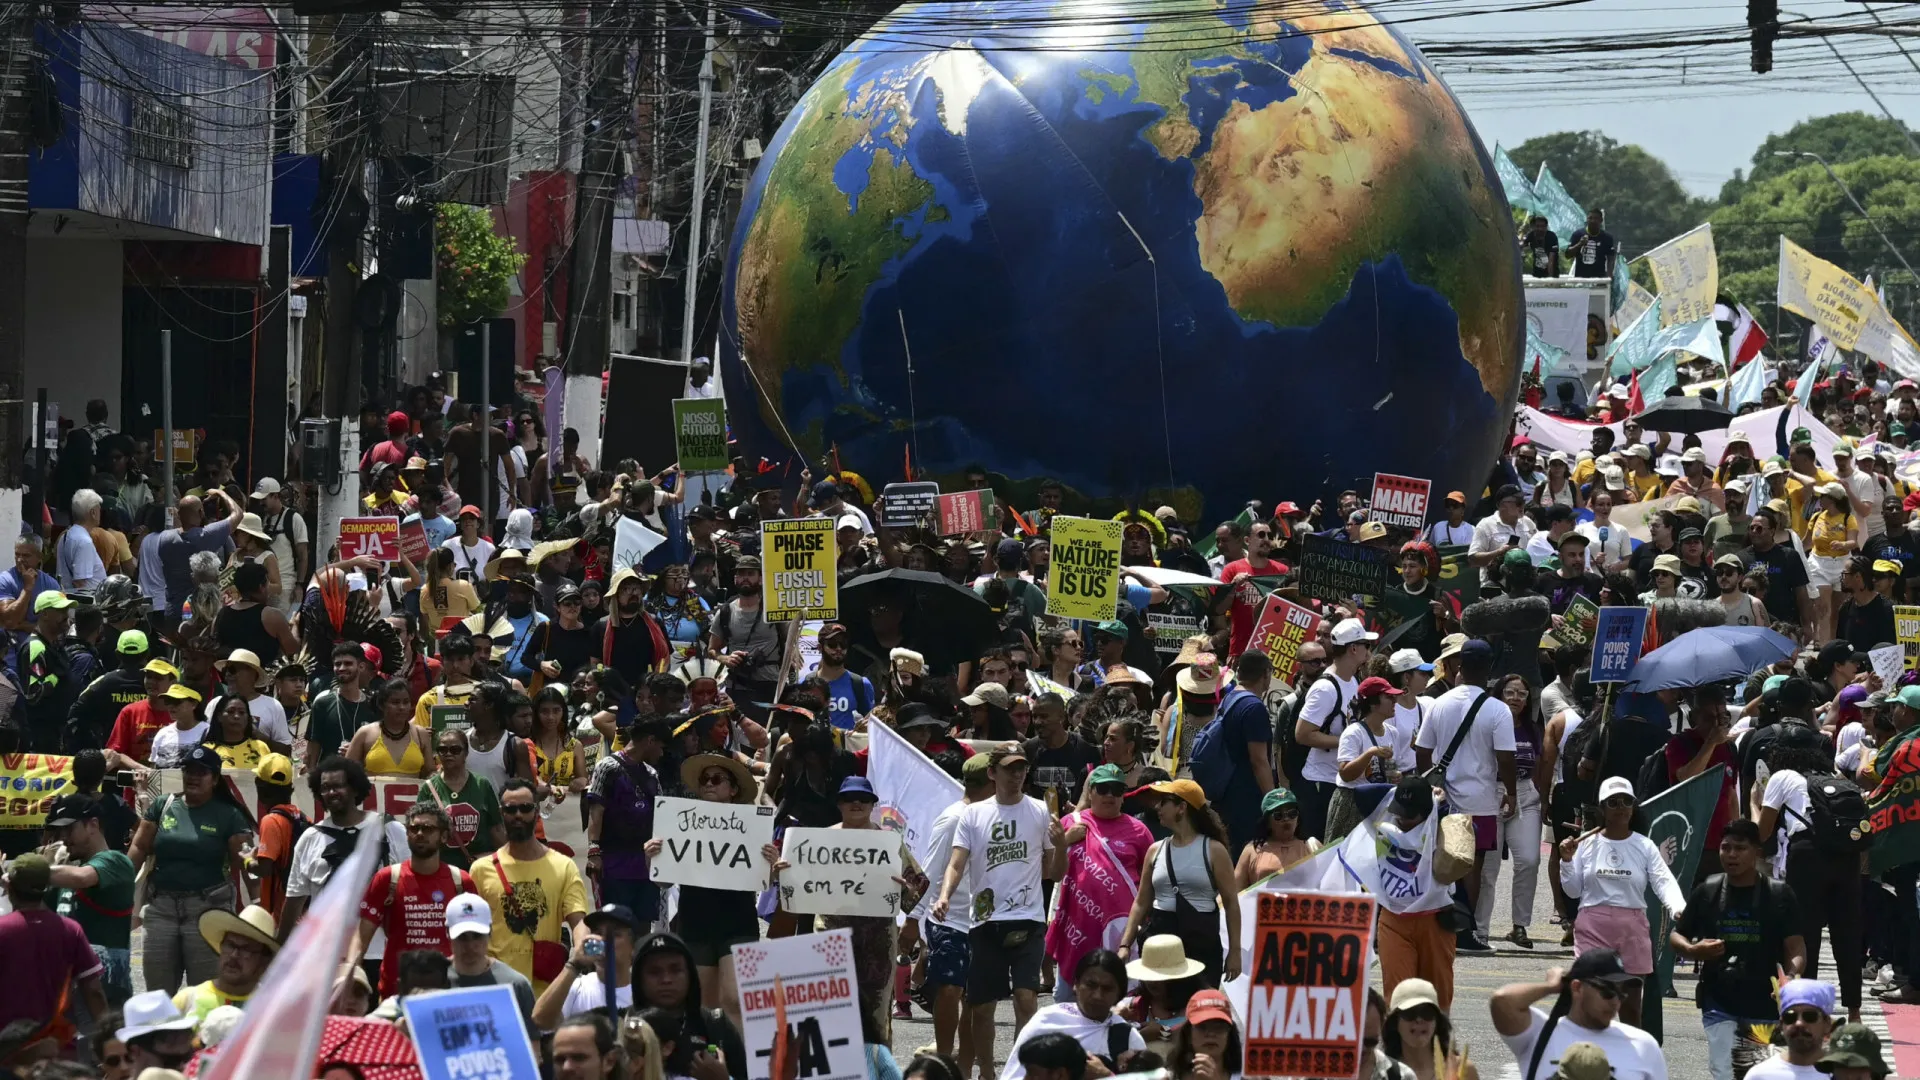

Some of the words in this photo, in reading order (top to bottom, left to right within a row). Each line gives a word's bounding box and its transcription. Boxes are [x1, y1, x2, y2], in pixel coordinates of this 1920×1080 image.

[1526, 301, 1568, 309] UVENTUDES
[682, 412, 717, 424] NOSSO
[681, 423, 721, 436] FUTURO
[691, 446, 725, 457] VENDA
[1373, 487, 1426, 516] MAKE
[764, 522, 782, 532] FAST
[784, 521, 799, 531] AND
[800, 519, 833, 530] FOREVER
[1371, 510, 1422, 528] POLLUTERS
[774, 533, 824, 552] PHASE
[1069, 538, 1084, 547] WE
[1085, 541, 1103, 549] ARE
[784, 552, 815, 570] OUT
[1052, 544, 1119, 569] NATURE
[1057, 563, 1072, 573] THE
[1074, 566, 1112, 577] ANSWER
[773, 570, 827, 590] FOSSIL
[1058, 572, 1077, 595] IS
[1080, 575, 1107, 599] US
[1304, 567, 1325, 583] OUR
[1326, 571, 1382, 593] LIBERATION
[777, 589, 824, 609] FUELS
[1311, 583, 1348, 601] BOUND
[768, 611, 786, 621] FAST
[787, 610, 800, 620] AN
[804, 609, 836, 619] OREVER
[1149, 615, 1162, 623] COP
[1163, 616, 1172, 624] DA
[1173, 617, 1197, 626] VIRAD
[1286, 607, 1312, 629] END
[1281, 621, 1307, 643] THE
[1264, 632, 1299, 659] FOSS
[1603, 641, 1630, 655] POVOS
[1267, 650, 1295, 674] FUEL
[1601, 655, 1614, 670] DE
[455, 815, 478, 825] VENDA
[677, 806, 748, 834] Floresta
[992, 820, 1016, 841] EU
[667, 838, 752, 868] VIVA
[793, 838, 891, 865] FLORESTA
[404, 902, 444, 912] TRANSIÇÃO
[405, 919, 443, 927] ECOLÓGICA
[1255, 931, 1361, 986] AGRO
[743, 975, 851, 1012] DEMRCAÇÃO
[1249, 985, 1356, 1042] MATA
[445, 1047, 511, 1080] POVOS
